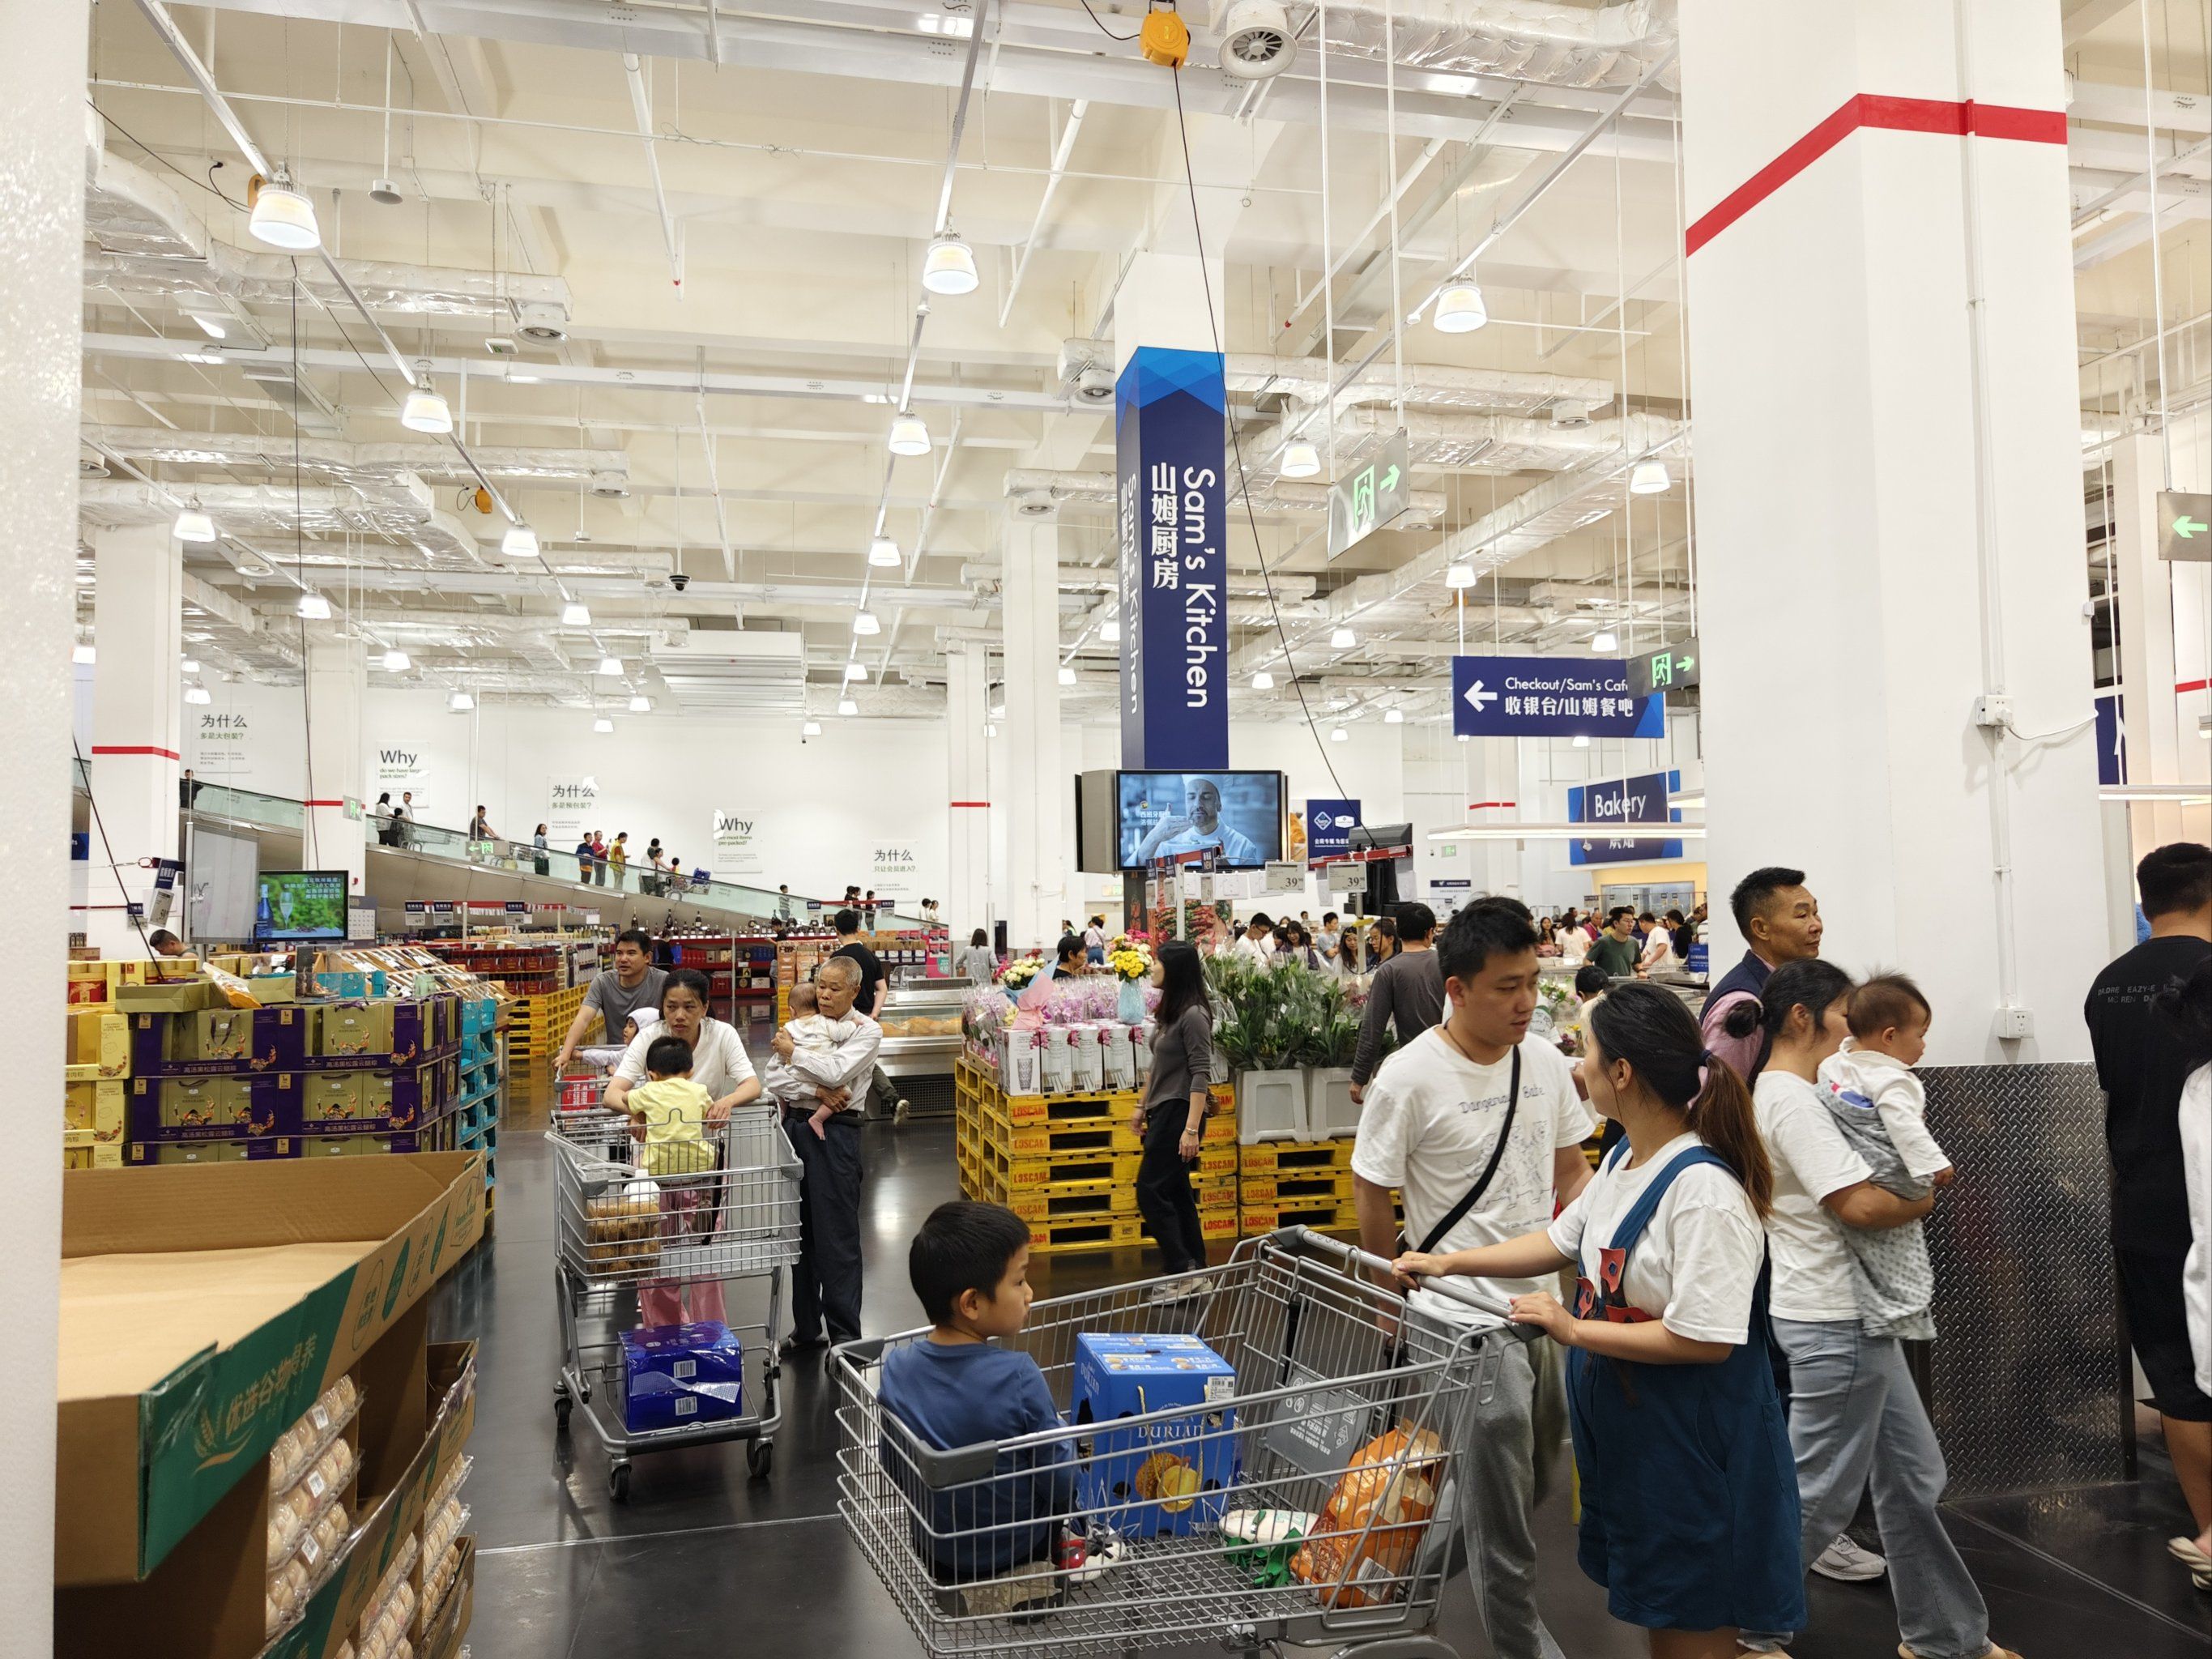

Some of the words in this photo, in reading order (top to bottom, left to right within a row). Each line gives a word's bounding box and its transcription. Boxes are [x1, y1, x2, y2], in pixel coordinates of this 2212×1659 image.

[1183, 466, 1216, 570] Sam's
[1151, 462, 1179, 591] 山姆厨房
[1185, 583, 1218, 708] Kitchen
[1505, 677, 1601, 693] Checkout/Sam's
[1505, 697, 1634, 717] 收银台/山姆餐吧
[201, 714, 248, 727] 为什么
[380, 749, 417, 767] Why
[552, 784, 595, 798] 为什么
[1595, 791, 1647, 819] Bakery
[718, 817, 753, 834] Why
[874, 849, 914, 862] 为什么
[1285, 877, 1298, 888] 39
[1347, 877, 1360, 888] 39
[2127, 984, 2155, 993] EAZY-E
[1012, 1106, 1046, 1118] LOSCAM
[1014, 1138, 1046, 1149] LOSCAM
[1204, 1158, 1234, 1169] LOSCAM
[1244, 1158, 1275, 1168] LOSCAM
[1013, 1172, 1046, 1183] LOSCAM
[1203, 1192, 1234, 1202] LOSCAM
[1012, 1205, 1046, 1215] LOSCAM
[1204, 1219, 1235, 1230] LOSCAM
[1244, 1216, 1276, 1227] LOSCAM
[1028, 1234, 1046, 1244] CAM
[1138, 1424, 1202, 1439] DURIAN
